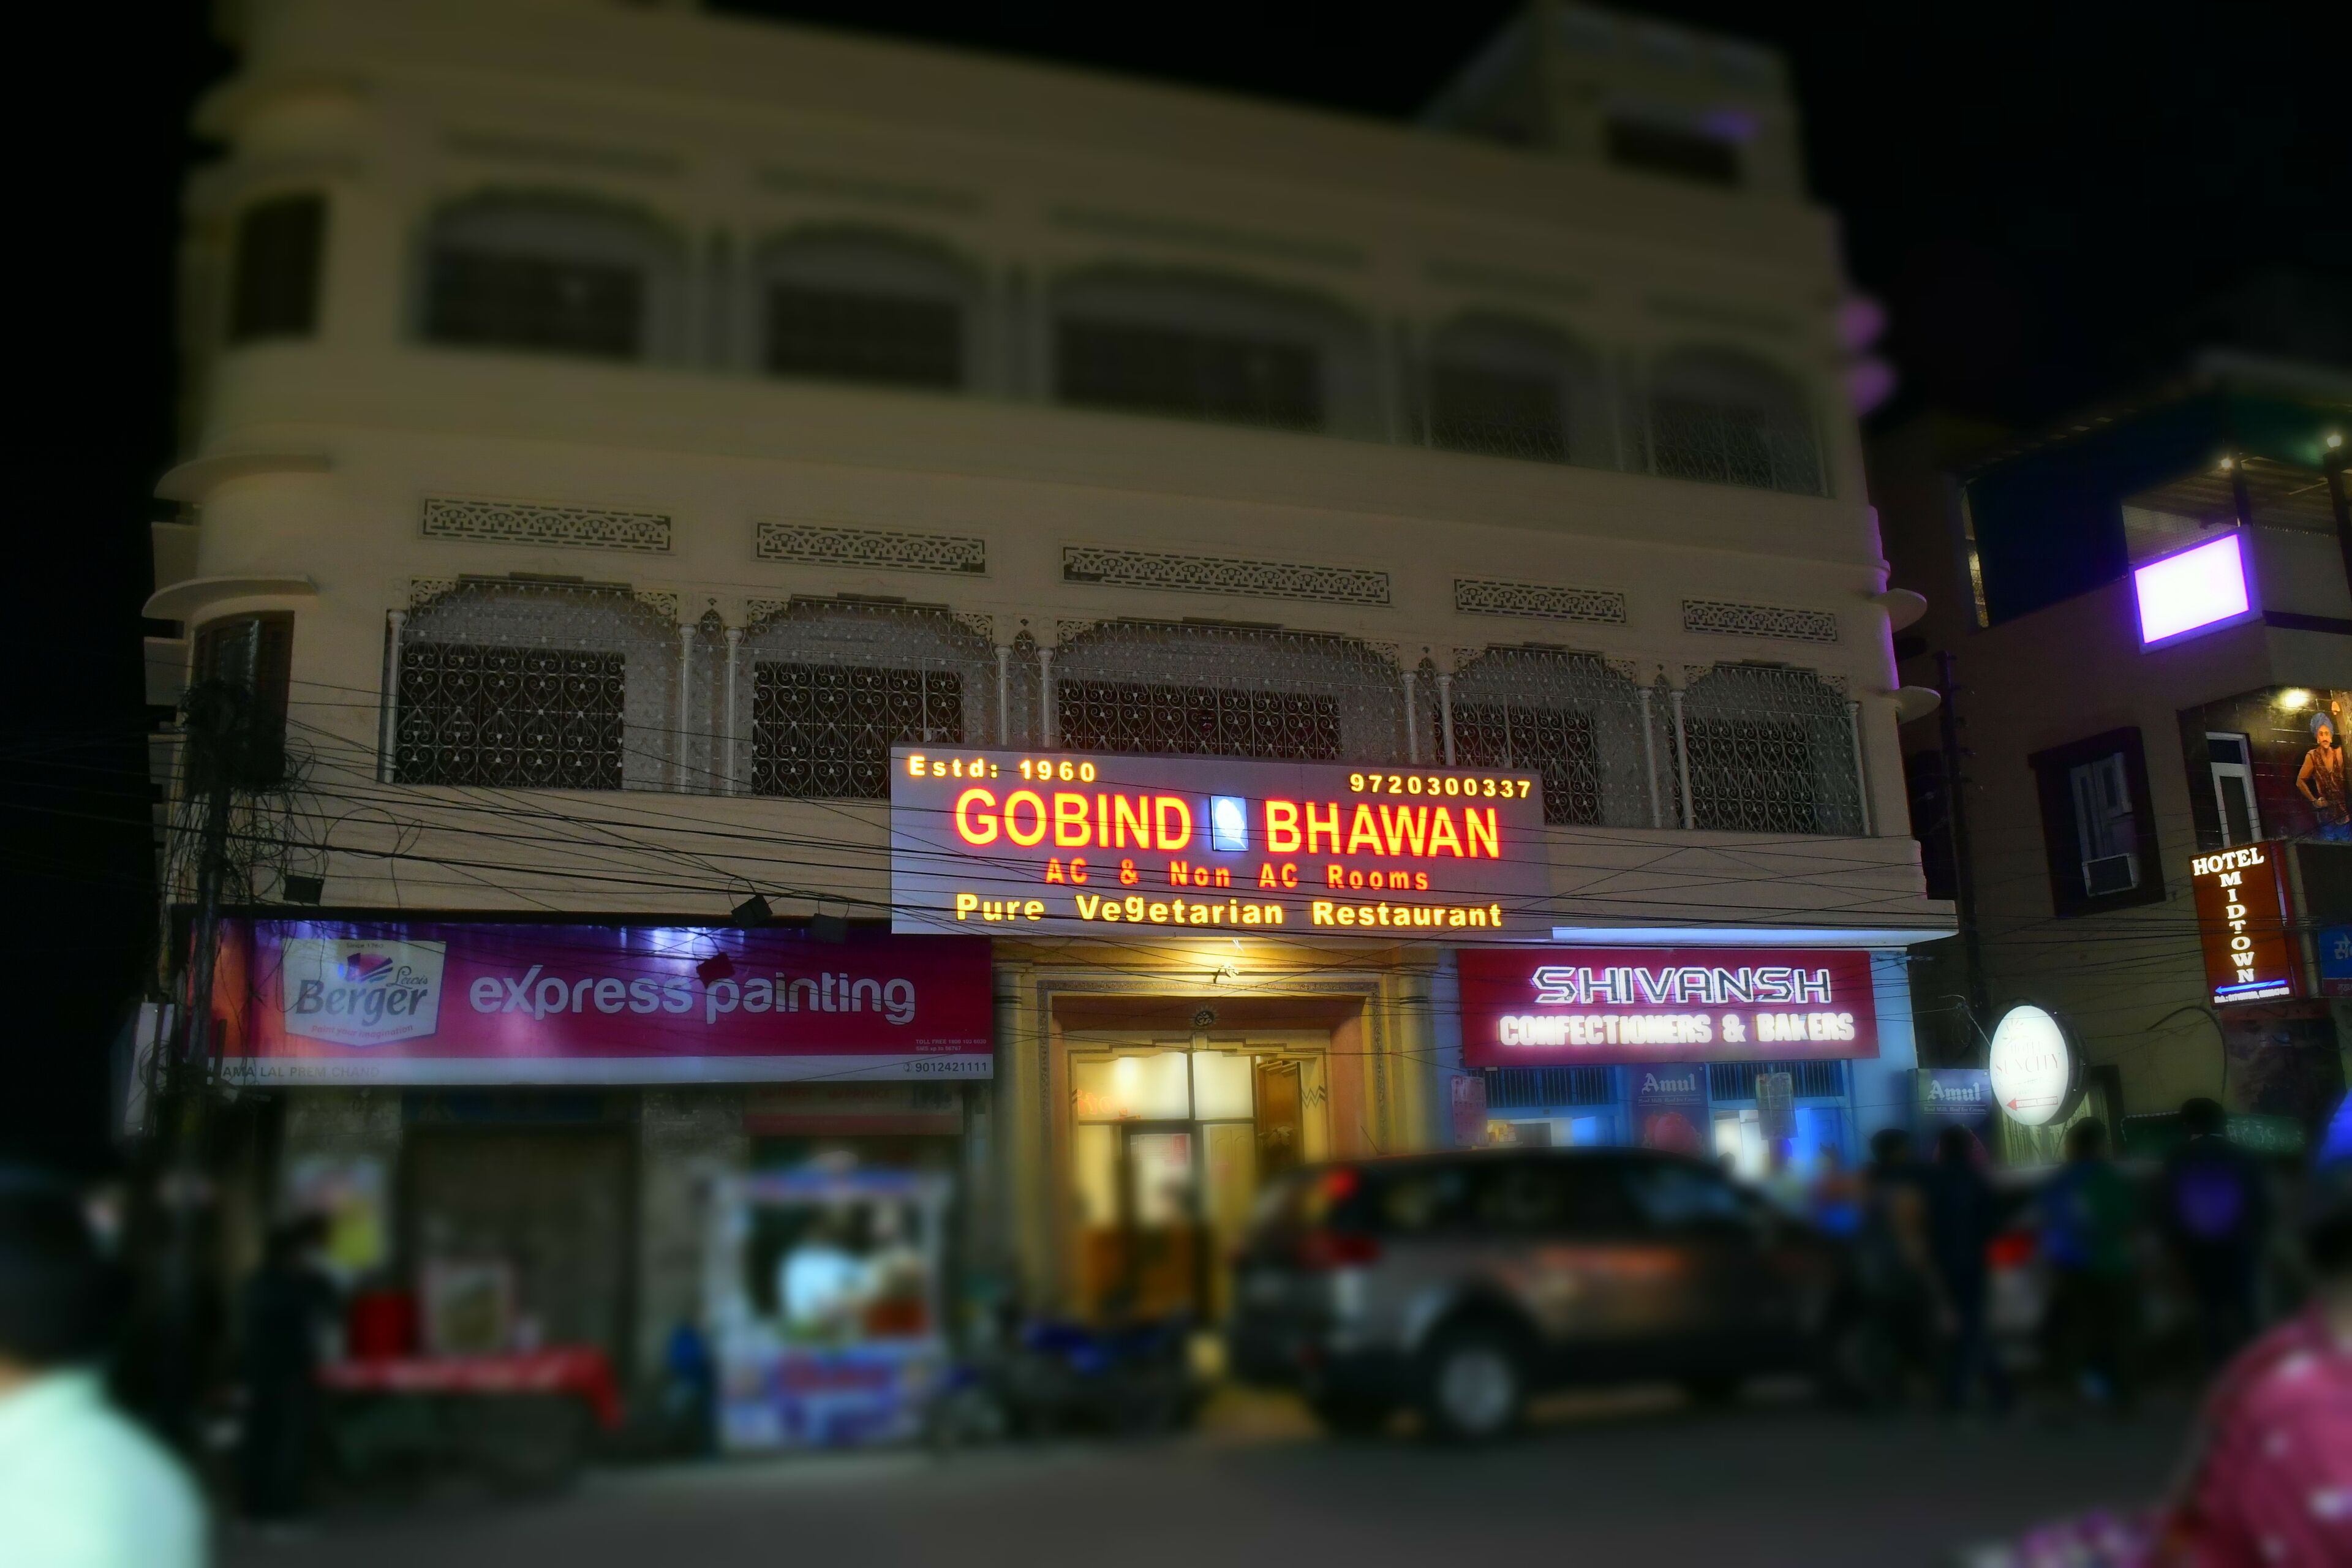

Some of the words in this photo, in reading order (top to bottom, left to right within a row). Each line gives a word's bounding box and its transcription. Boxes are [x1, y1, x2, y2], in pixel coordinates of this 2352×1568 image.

[908, 756, 998, 778] Estd:
[1019, 760, 1096, 782] 1960
[1350, 773, 1530, 798] 9720300337
[956, 788, 1191, 850] GOBIND
[1265, 800, 1499, 858] BHAWAN
[1045, 858, 1088, 884] AC
[1120, 859, 1139, 885] &
[1169, 861, 1230, 887] Non
[1259, 862, 1298, 888] AC
[1327, 864, 1428, 890] Rooms
[2192, 847, 2264, 876] HOTEL
[956, 893, 1044, 921] Pure
[1075, 895, 1282, 925] Vegetarian
[1312, 901, 1502, 927] Restaurant
[2218, 871, 2255, 983] MIDTOWN
[386, 965, 429, 989] Lewis
[1532, 966, 1832, 1004] SHIVANSH
[295, 979, 428, 1027] Berger
[706, 971, 915, 1025] painting
[1499, 1014, 1713, 1046] CONFECTIONERS
[1722, 1014, 1746, 1043] &
[1755, 1012, 1855, 1042] BAKERS
[261, 1066, 285, 1077] LAL
[290, 1066, 326, 1077] PREM
[332, 1066, 379, 1077] CHAND
[916, 1062, 987, 1072] 9012421111
[1996, 1052, 2061, 1076] SUNCITY
[1642, 1072, 1697, 1095] Amul
[1926, 1079, 1981, 1103] Amul
